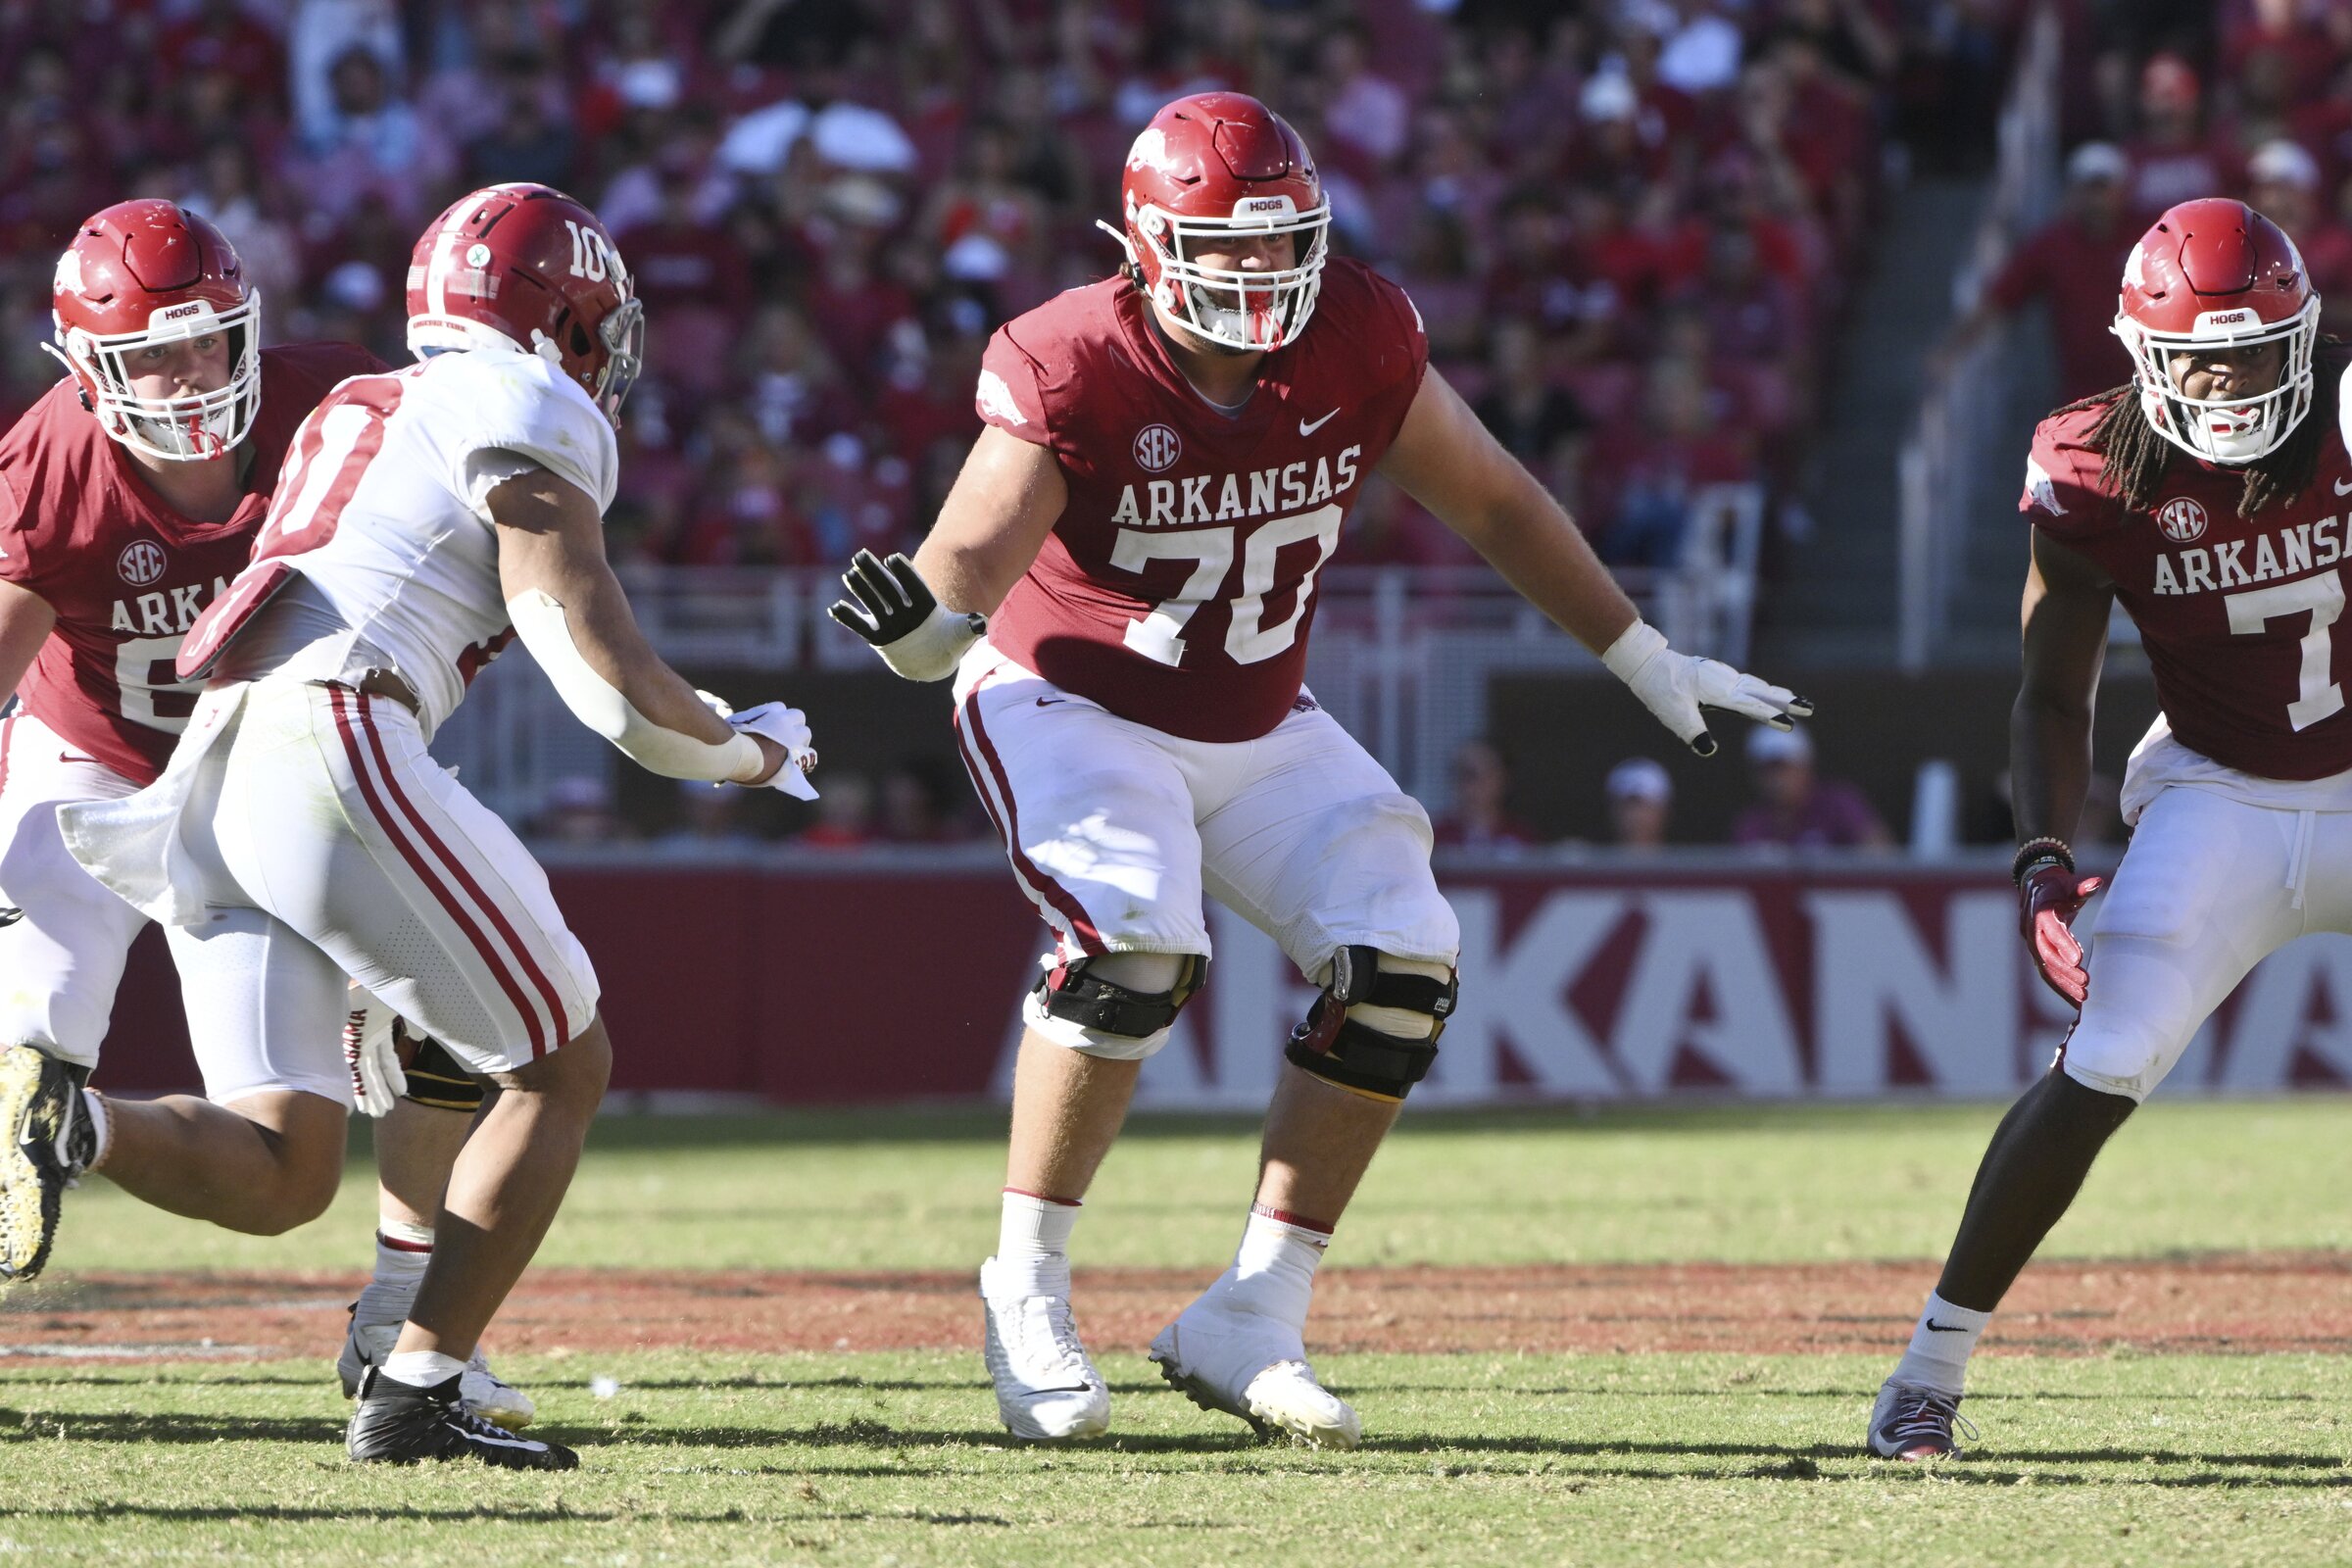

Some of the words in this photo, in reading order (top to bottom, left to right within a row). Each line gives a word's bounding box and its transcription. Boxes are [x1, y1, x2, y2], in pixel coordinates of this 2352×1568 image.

[1250, 199, 1283, 212] HOGS
[565, 220, 607, 282] 10
[165, 305, 200, 320] HOGS
[2210, 313, 2245, 324] HOGS
[1138, 428, 1176, 468] SEC
[1111, 443, 1361, 526] ARKANSAS
[2163, 501, 2203, 540] SEC
[121, 544, 162, 583] SEC
[2153, 512, 2352, 595] ARKANS
[1108, 503, 1344, 668] 70
[2224, 568, 2346, 733] 7
